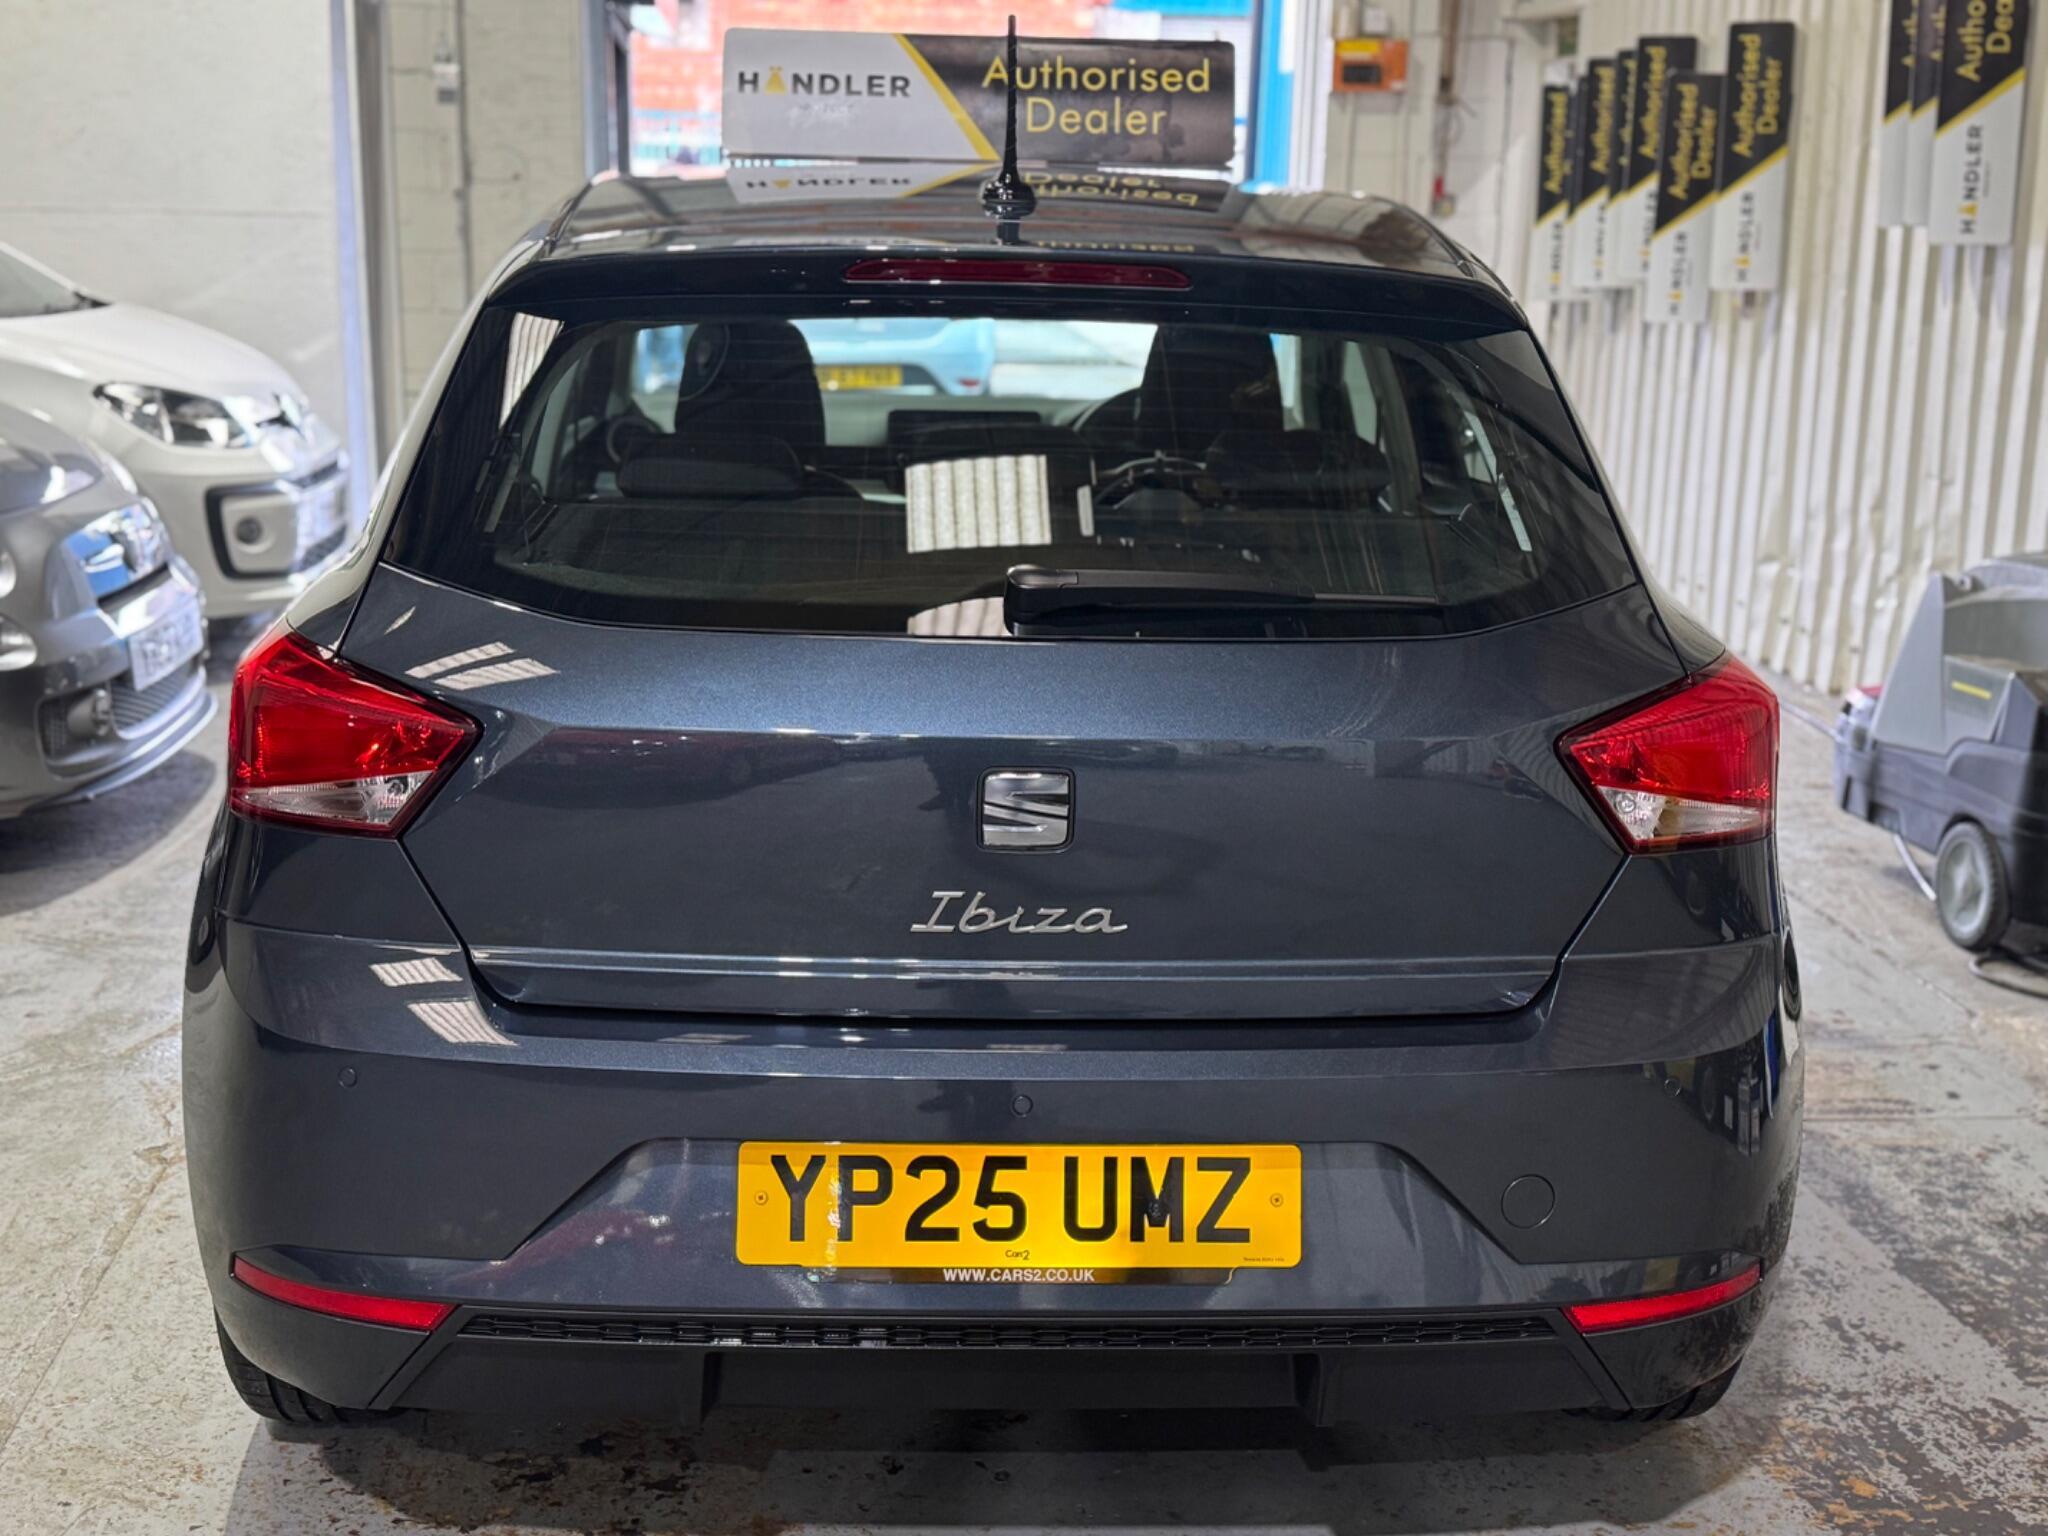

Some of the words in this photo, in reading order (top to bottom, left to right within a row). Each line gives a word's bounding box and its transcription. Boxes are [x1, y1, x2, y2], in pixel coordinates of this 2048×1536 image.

[981, 55, 1210, 93] Authorised
[1732, 33, 1762, 158] Authorised
[1755, 56, 1783, 135] Dealer
[1026, 96, 1167, 135] Dealer
[1667, 82, 1699, 200] Authorised
[1691, 105, 1718, 179] Dealer
[910, 891, 1128, 933] Ibiza
[770, 1155, 1028, 1243] YP25
[1064, 1156, 1252, 1243] UMZ
[943, 1268, 1096, 1282] WWW.CARS2.CO.UK
